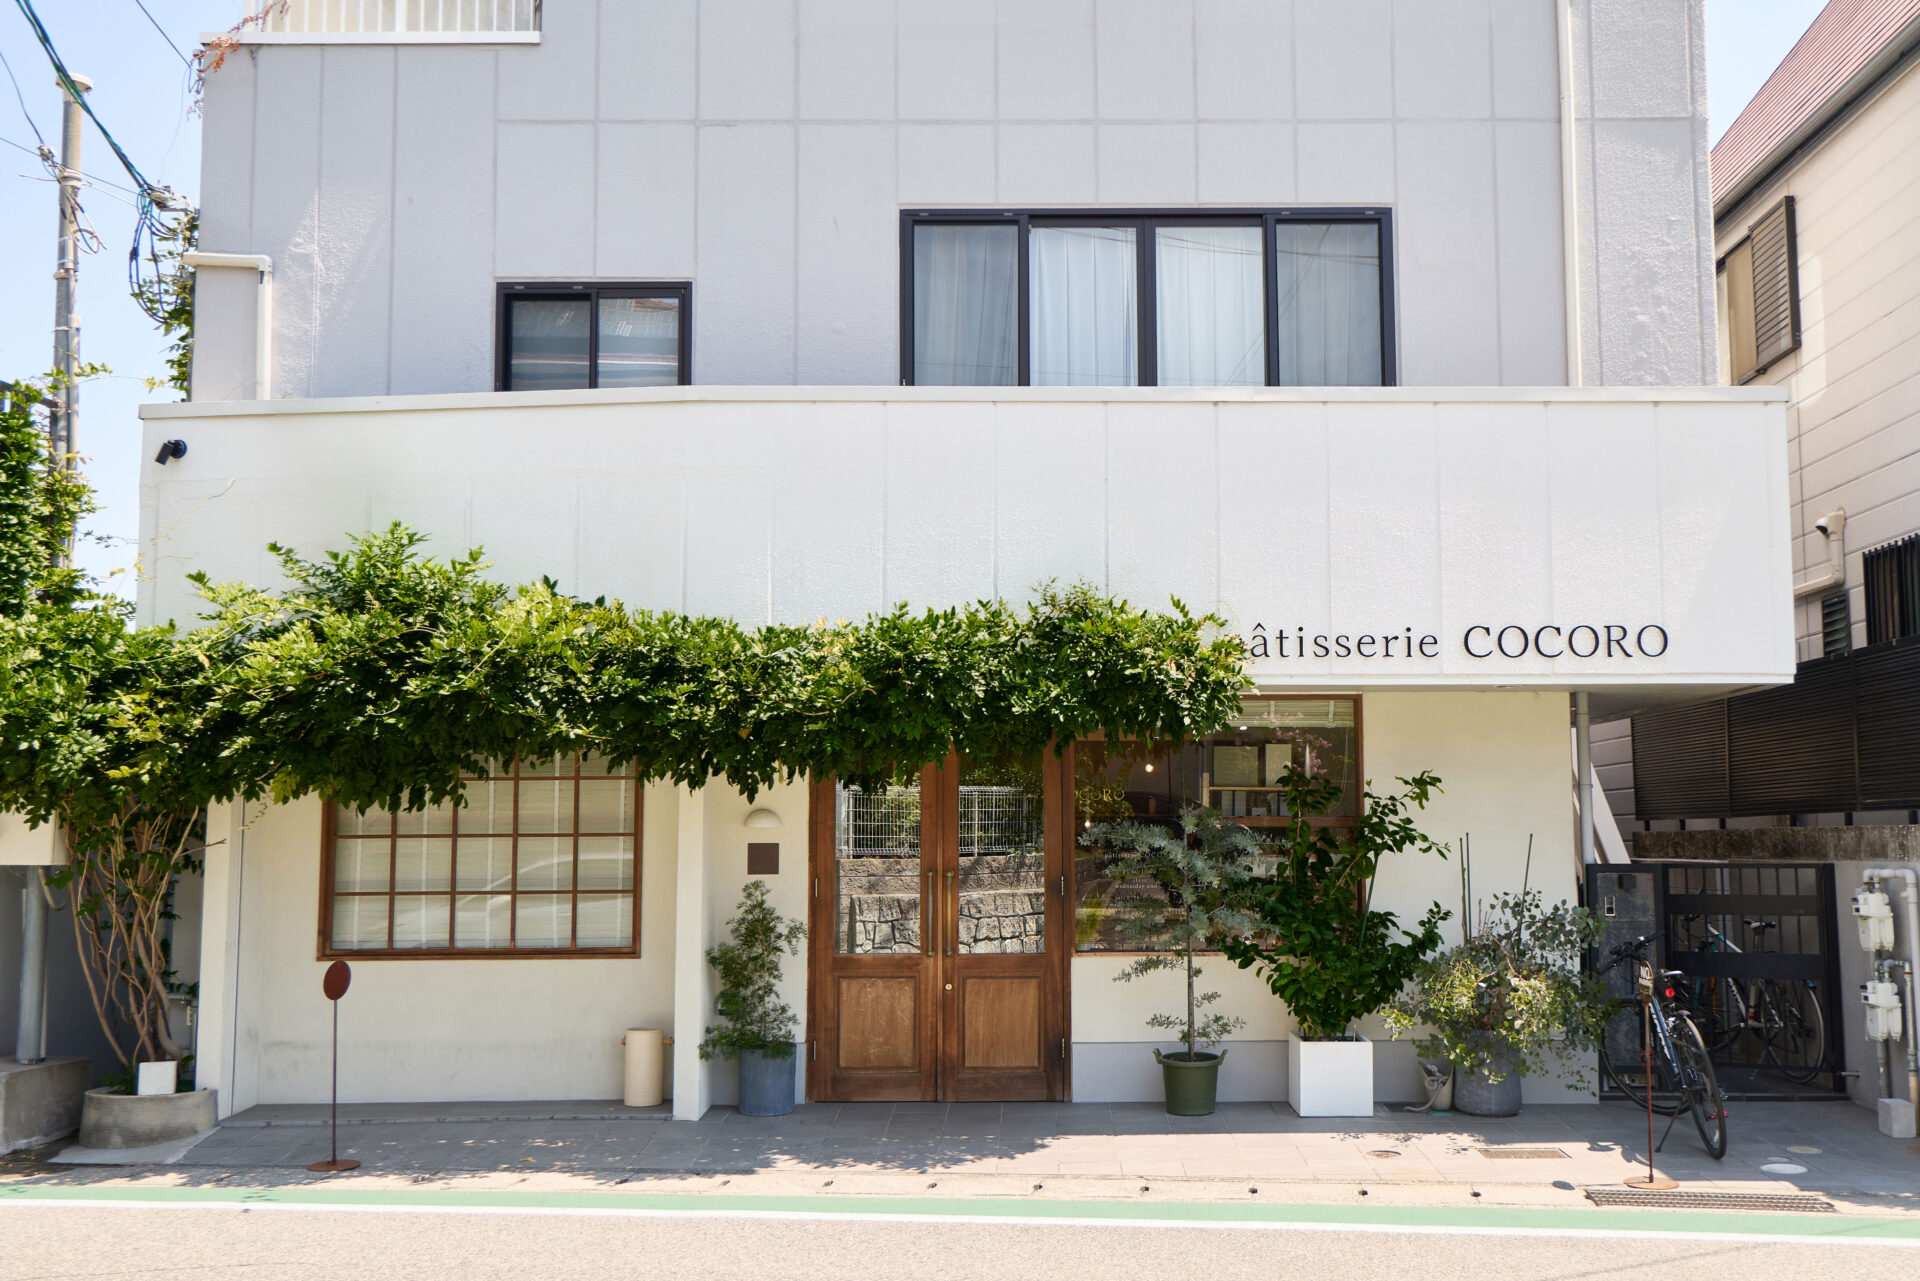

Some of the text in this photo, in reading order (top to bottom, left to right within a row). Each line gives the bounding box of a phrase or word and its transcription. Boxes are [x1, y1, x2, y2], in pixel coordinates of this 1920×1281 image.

[1250, 622, 1669, 659] âtisserie COCORO
[1640, 965, 1650, 979] NO
